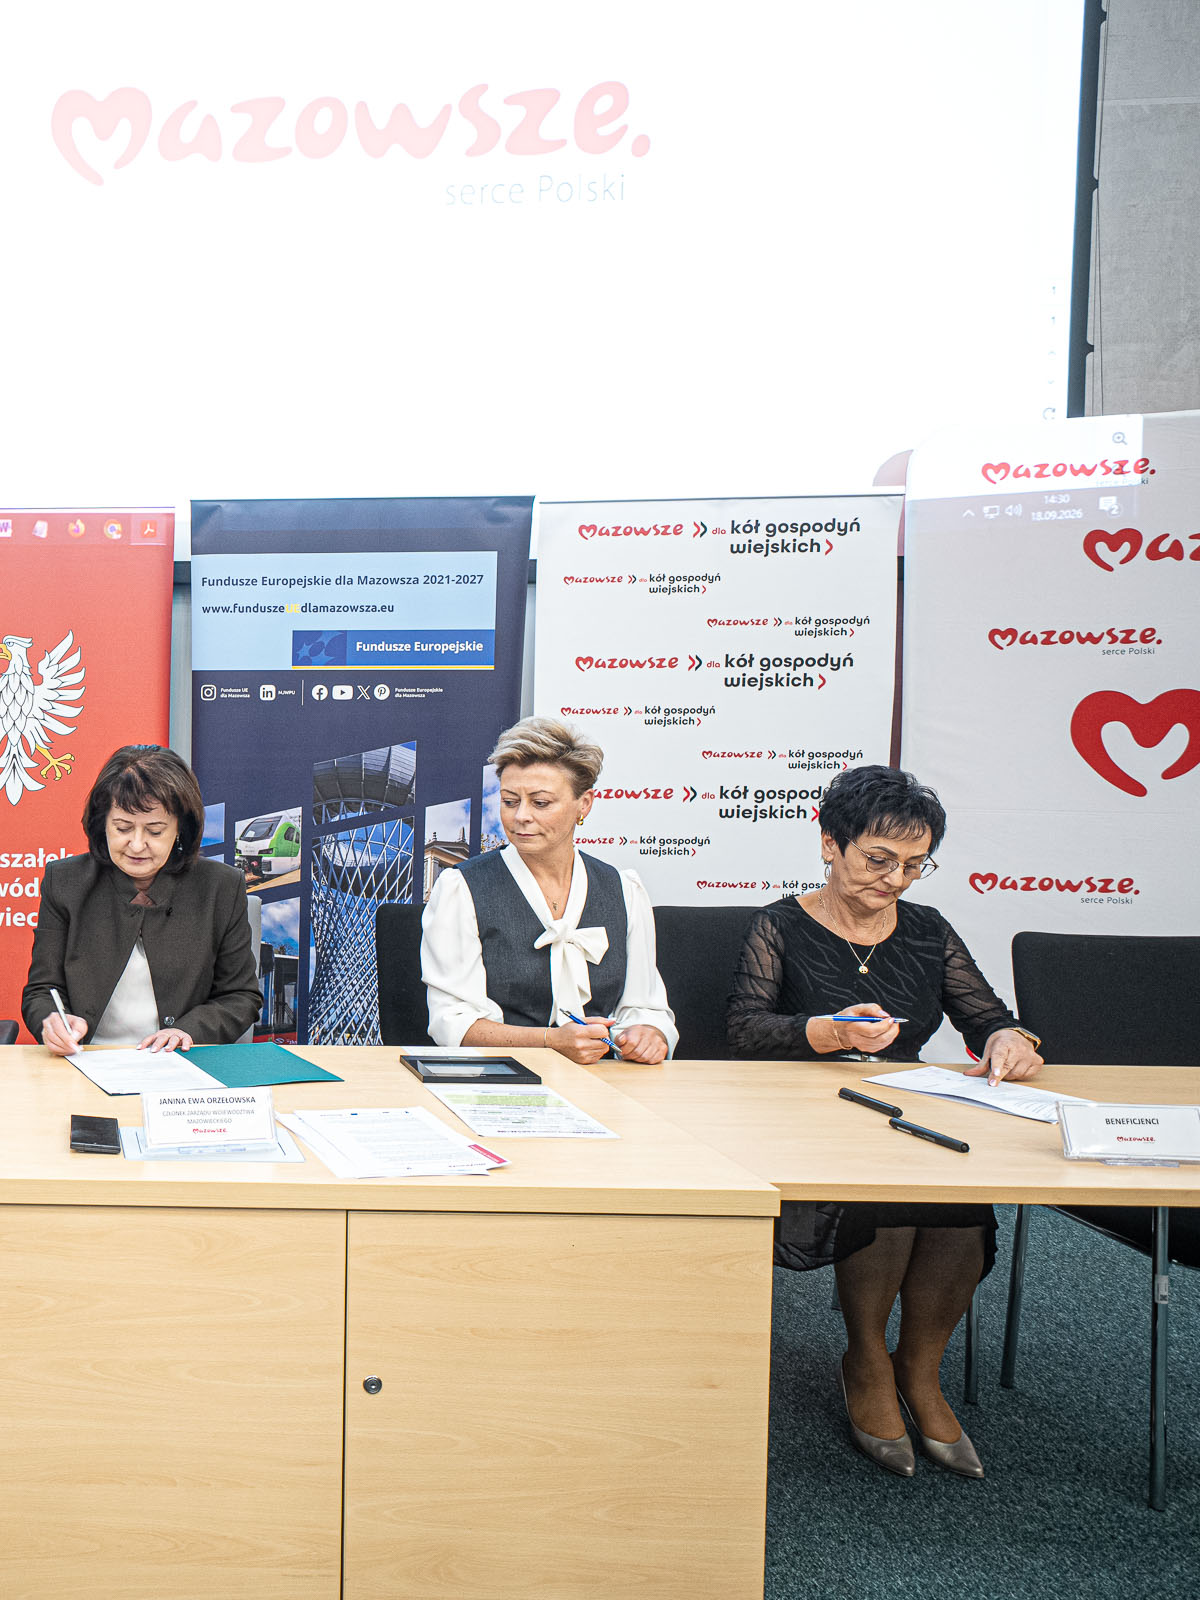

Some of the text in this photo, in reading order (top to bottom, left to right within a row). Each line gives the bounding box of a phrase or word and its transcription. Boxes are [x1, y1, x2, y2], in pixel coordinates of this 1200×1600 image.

[445, 173, 625, 206] serce Polski
[578, 517, 861, 541] Mazowsze dla kół gospodyń
[729, 538, 821, 557] wiejskich
[201, 573, 484, 588] Fundusze Europejskie dla Mazowsza 2021-2027
[563, 574, 623, 585] Mazowsze
[649, 573, 666, 583] kół
[668, 572, 721, 585] gospodyń
[649, 584, 700, 596] wiejskich
[201, 602, 395, 614] www.funduszeUEdlamazowsza.eu
[707, 617, 769, 628] Mazowsze
[794, 616, 812, 626] kół
[814, 615, 870, 628] gospodyń
[794, 627, 847, 638] wiejskich
[988, 627, 1162, 650] Mazowsze.
[356, 640, 484, 655] Fundusze Europejskie
[1128, 647, 1155, 655] Polski
[575, 652, 854, 672] Mazowsze dla kół gospodyń
[724, 673, 814, 691] wiejskich
[561, 706, 619, 717] Mazowsze
[644, 705, 661, 715] kół
[663, 705, 716, 717] gospodyń
[644, 716, 695, 727] wiejskich
[702, 750, 763, 760] Mazowsze
[788, 749, 805, 759] kół
[808, 749, 863, 761] gospodyń
[788, 760, 841, 771] wiejskich
[594, 786, 823, 804] azowsze dla kół gospod
[719, 805, 807, 822] wiejskich
[574, 836, 615, 845] zowsze
[639, 835, 656, 845] kół
[658, 835, 711, 847] gospodyń
[639, 847, 690, 858] wiejskich
[696, 880, 757, 890] Mazowsze
[782, 880, 799, 889] kół
[968, 872, 1140, 895] Mazowsze.
[1107, 896, 1133, 904] Polski
[159, 1097, 186, 1105] JANINA
[206, 1096, 256, 1104] ORZEŁOWSKA
